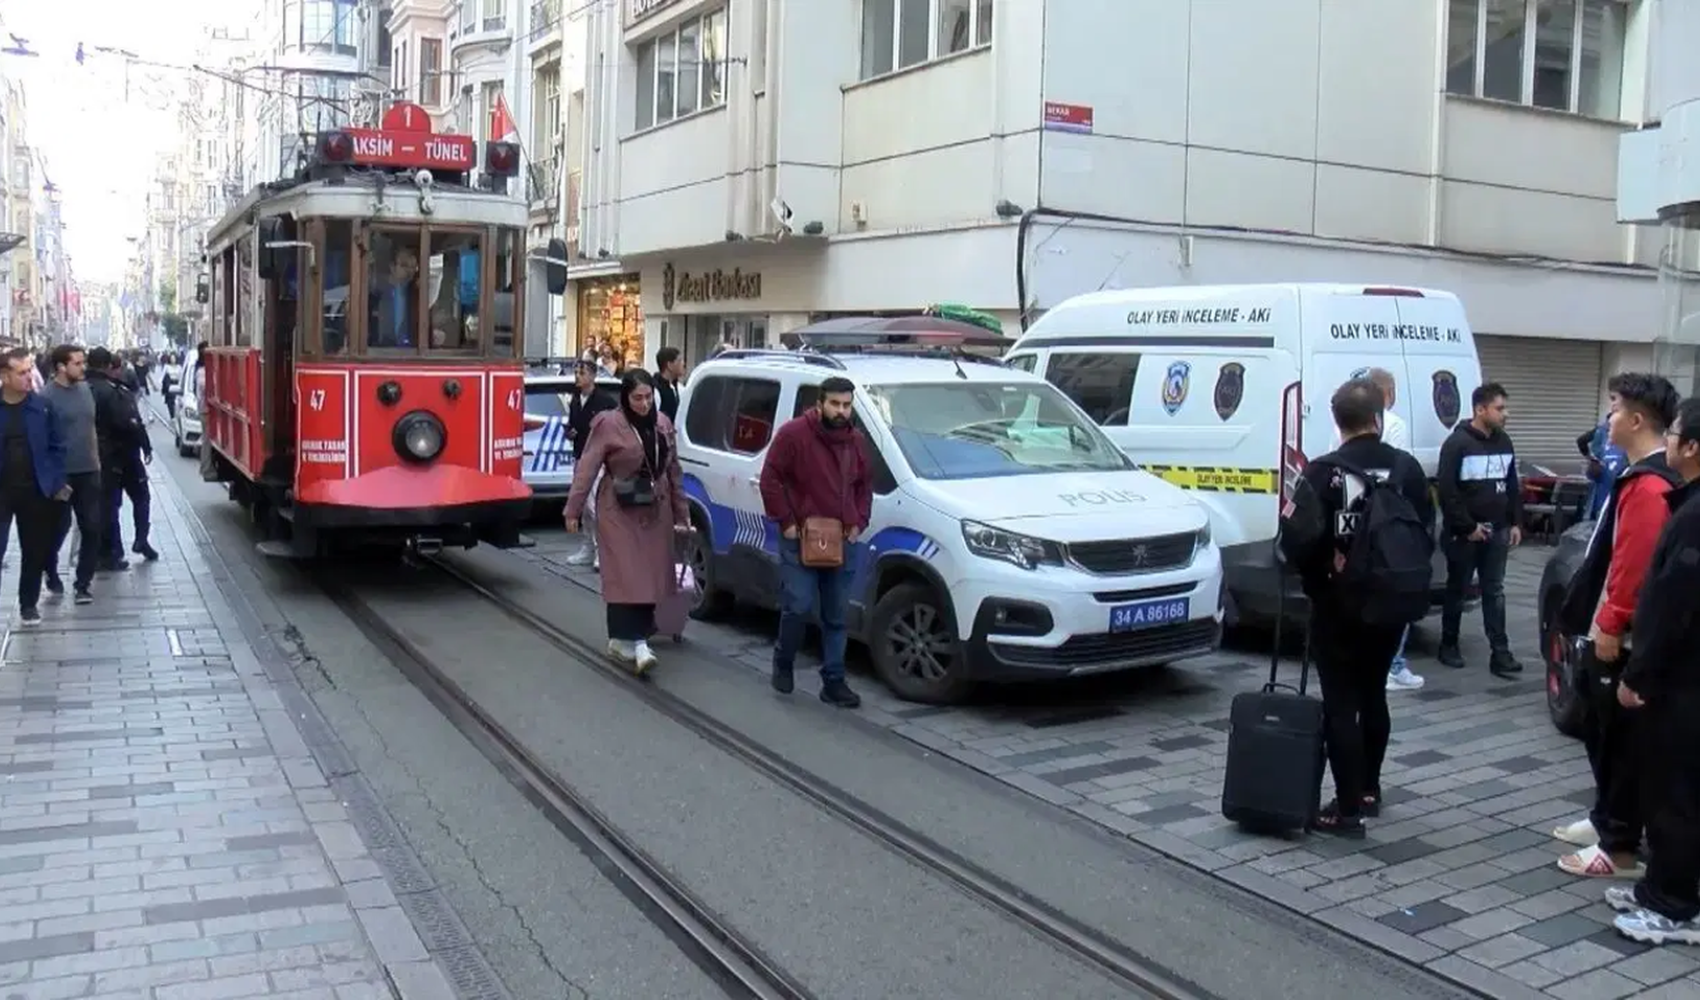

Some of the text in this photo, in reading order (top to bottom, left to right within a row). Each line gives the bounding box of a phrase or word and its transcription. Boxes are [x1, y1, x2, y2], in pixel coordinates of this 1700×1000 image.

[403, 105, 412, 128] 1
[352, 133, 393, 157] AKSİM
[424, 137, 468, 162] TÜNEL
[1127, 310, 1153, 325] OLAY
[1330, 323, 1361, 340] OLAY
[310, 388, 326, 411] 47
[1114, 601, 1185, 626] 34 A 86168
